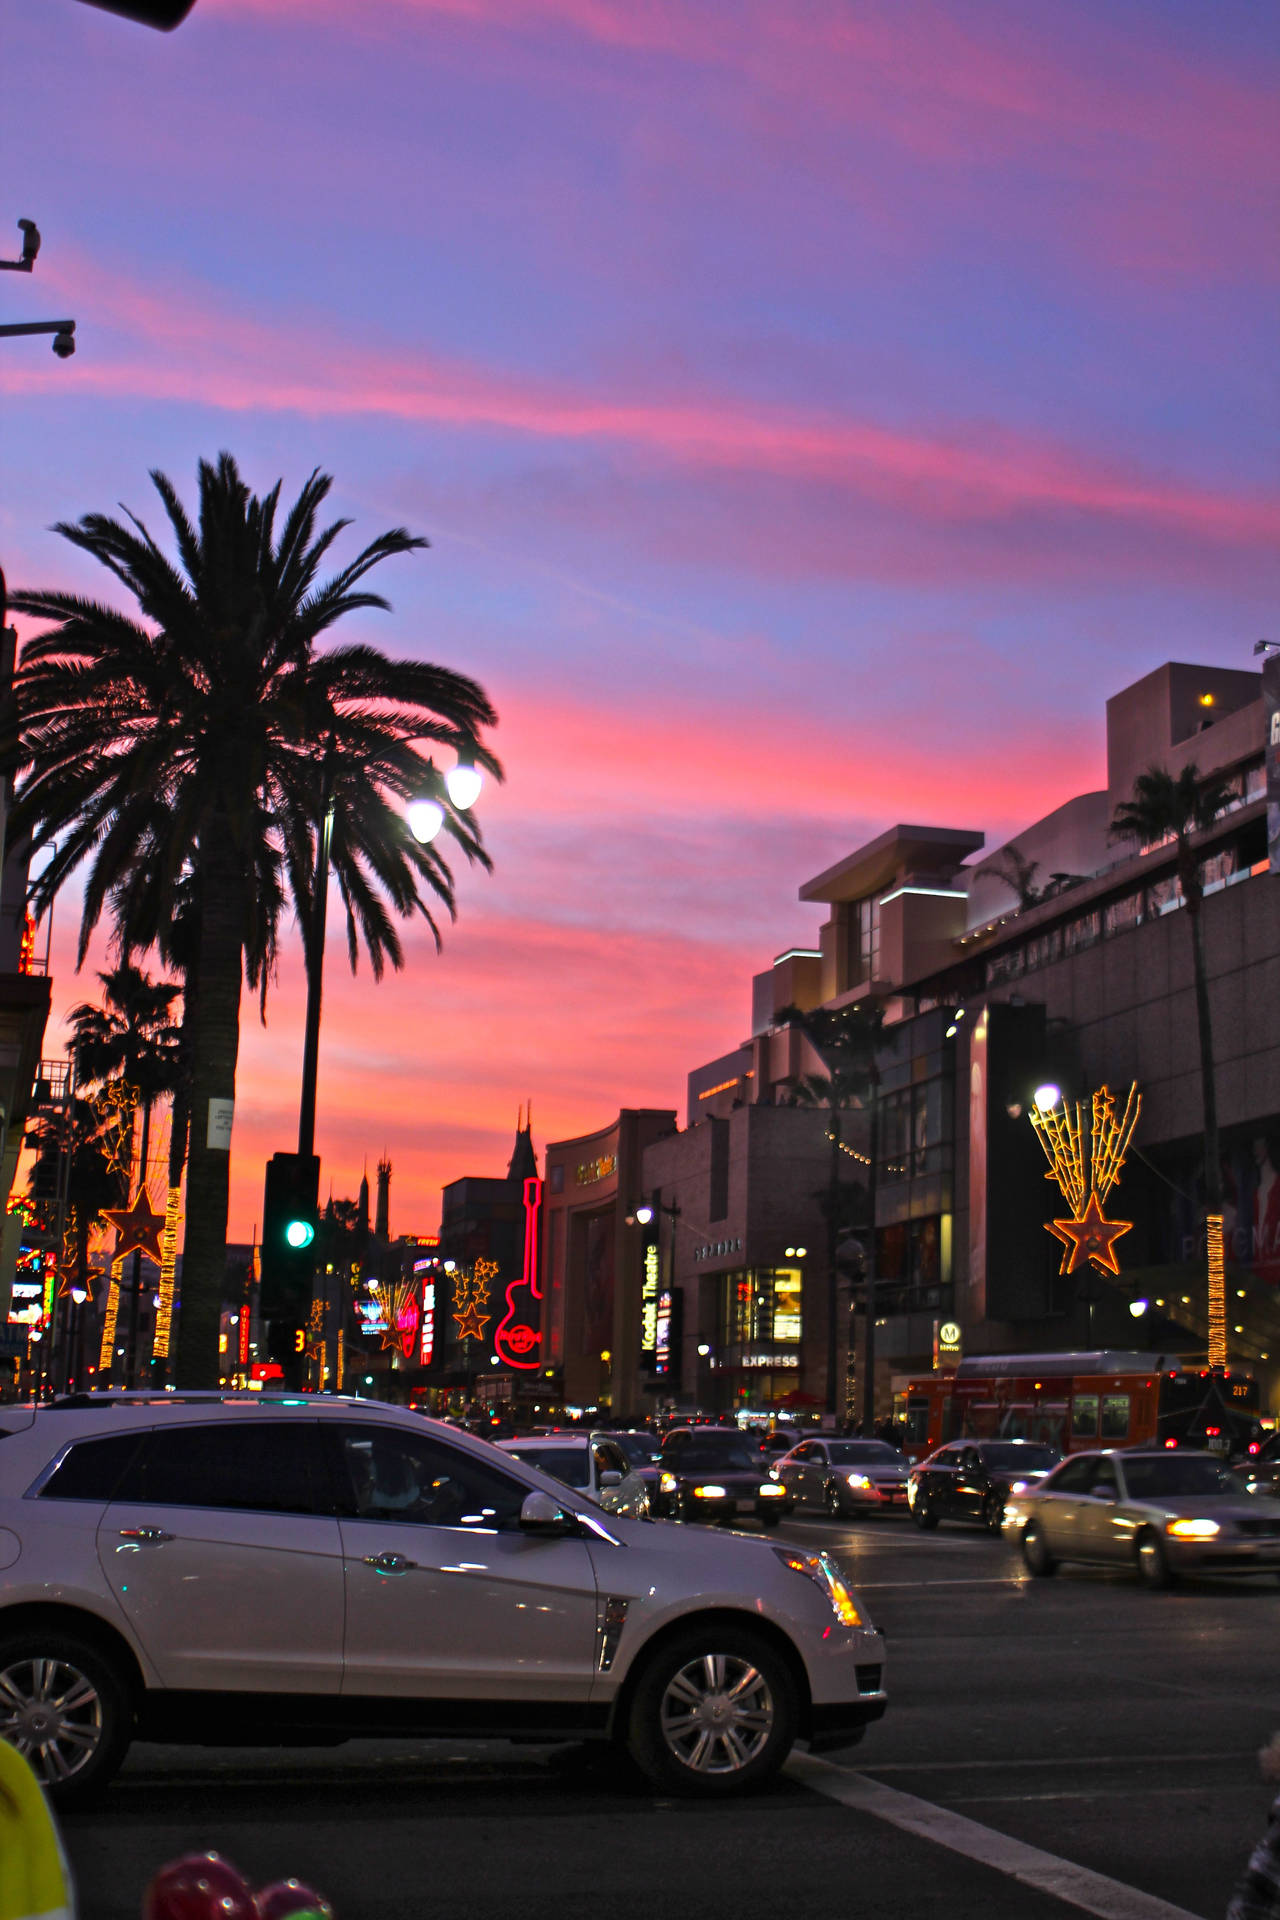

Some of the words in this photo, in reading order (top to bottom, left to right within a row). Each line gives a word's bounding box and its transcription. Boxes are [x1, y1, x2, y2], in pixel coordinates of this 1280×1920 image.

[643, 1245, 658, 1300] Theatre
[641, 1302, 656, 1350] Kodak
[944, 1327, 956, 1340] M
[295, 1329, 305, 1352] 3
[742, 1356, 798, 1367] EXPRESS
[1232, 1384, 1248, 1396] 217
